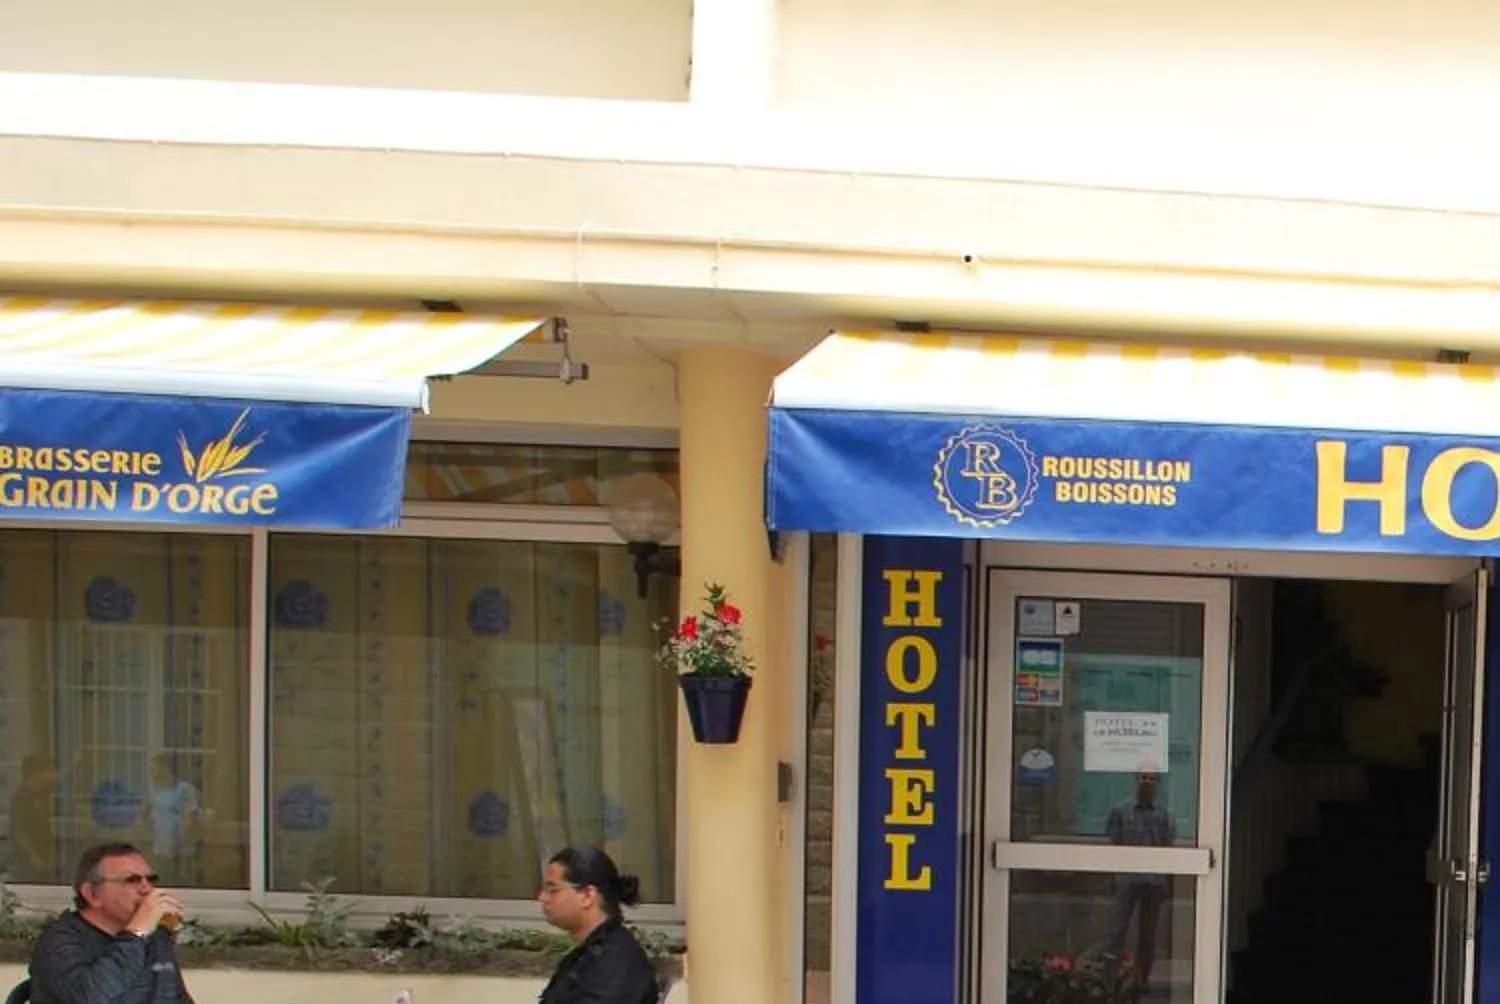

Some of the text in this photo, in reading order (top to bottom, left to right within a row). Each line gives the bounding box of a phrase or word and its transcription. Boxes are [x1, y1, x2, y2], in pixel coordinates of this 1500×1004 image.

[1042, 455, 1191, 482] ROUSSILLON
[1055, 481, 1178, 506] BOISSONS
[882, 569, 943, 891] HOTEL
